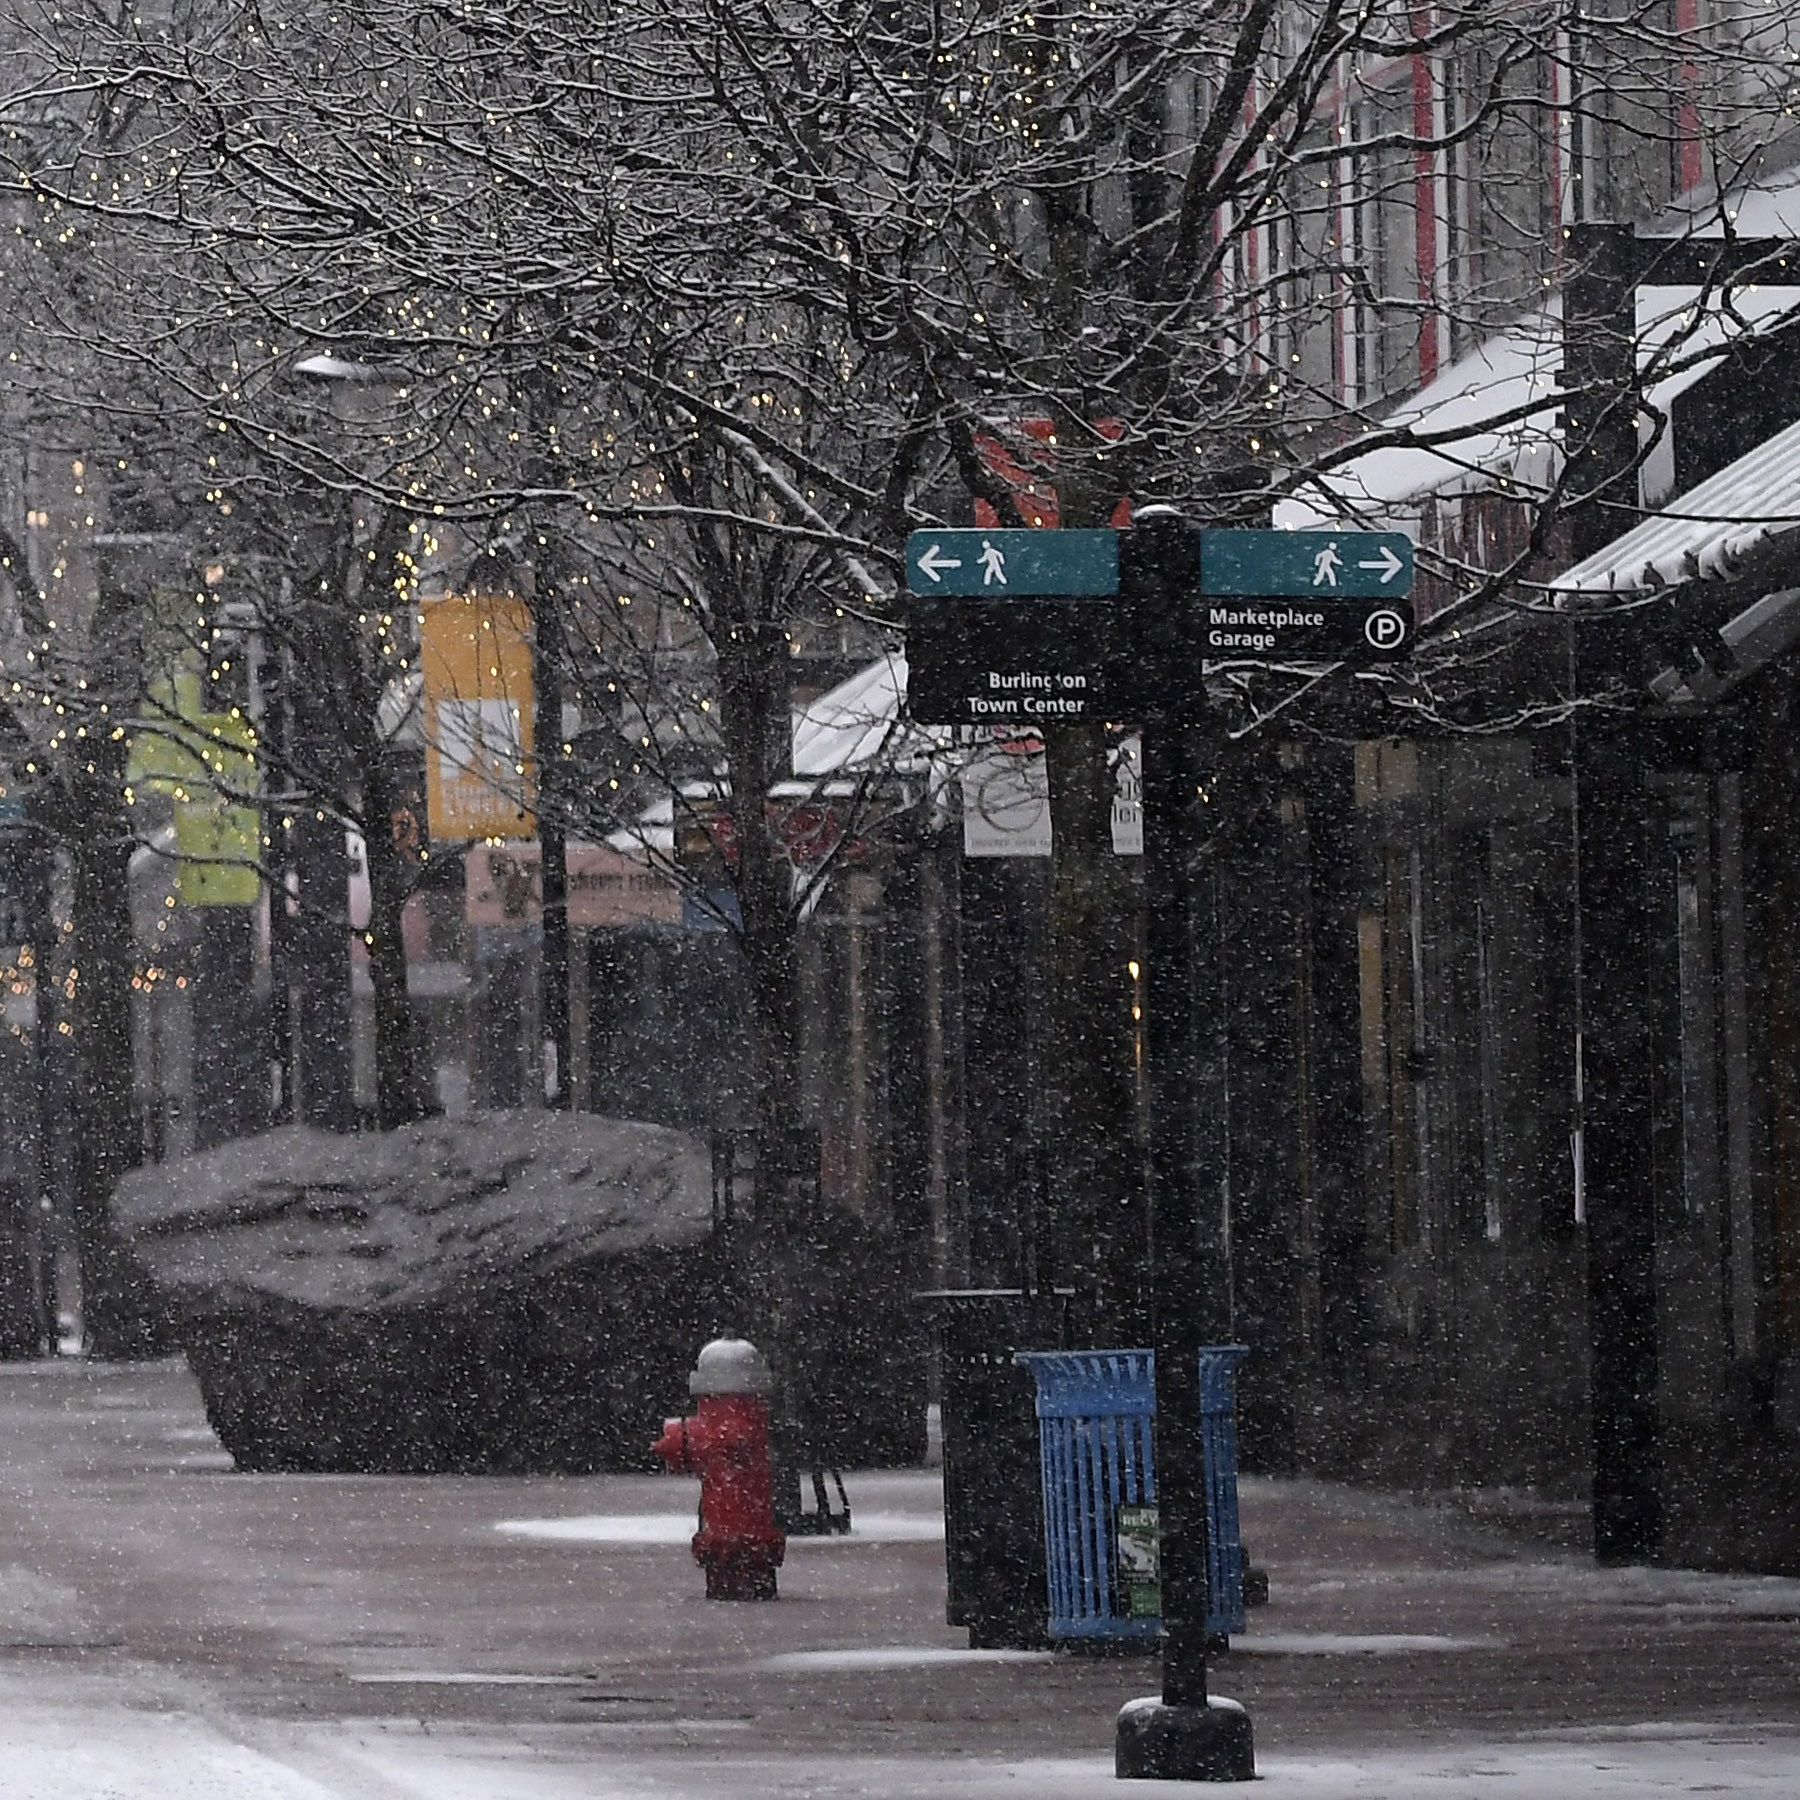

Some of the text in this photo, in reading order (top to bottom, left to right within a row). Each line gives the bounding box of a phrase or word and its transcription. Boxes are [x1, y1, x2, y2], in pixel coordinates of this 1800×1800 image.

[1209, 607, 1325, 630] Marketplace
[1208, 630, 1276, 651] Garage
[967, 695, 1085, 713] Town Center
